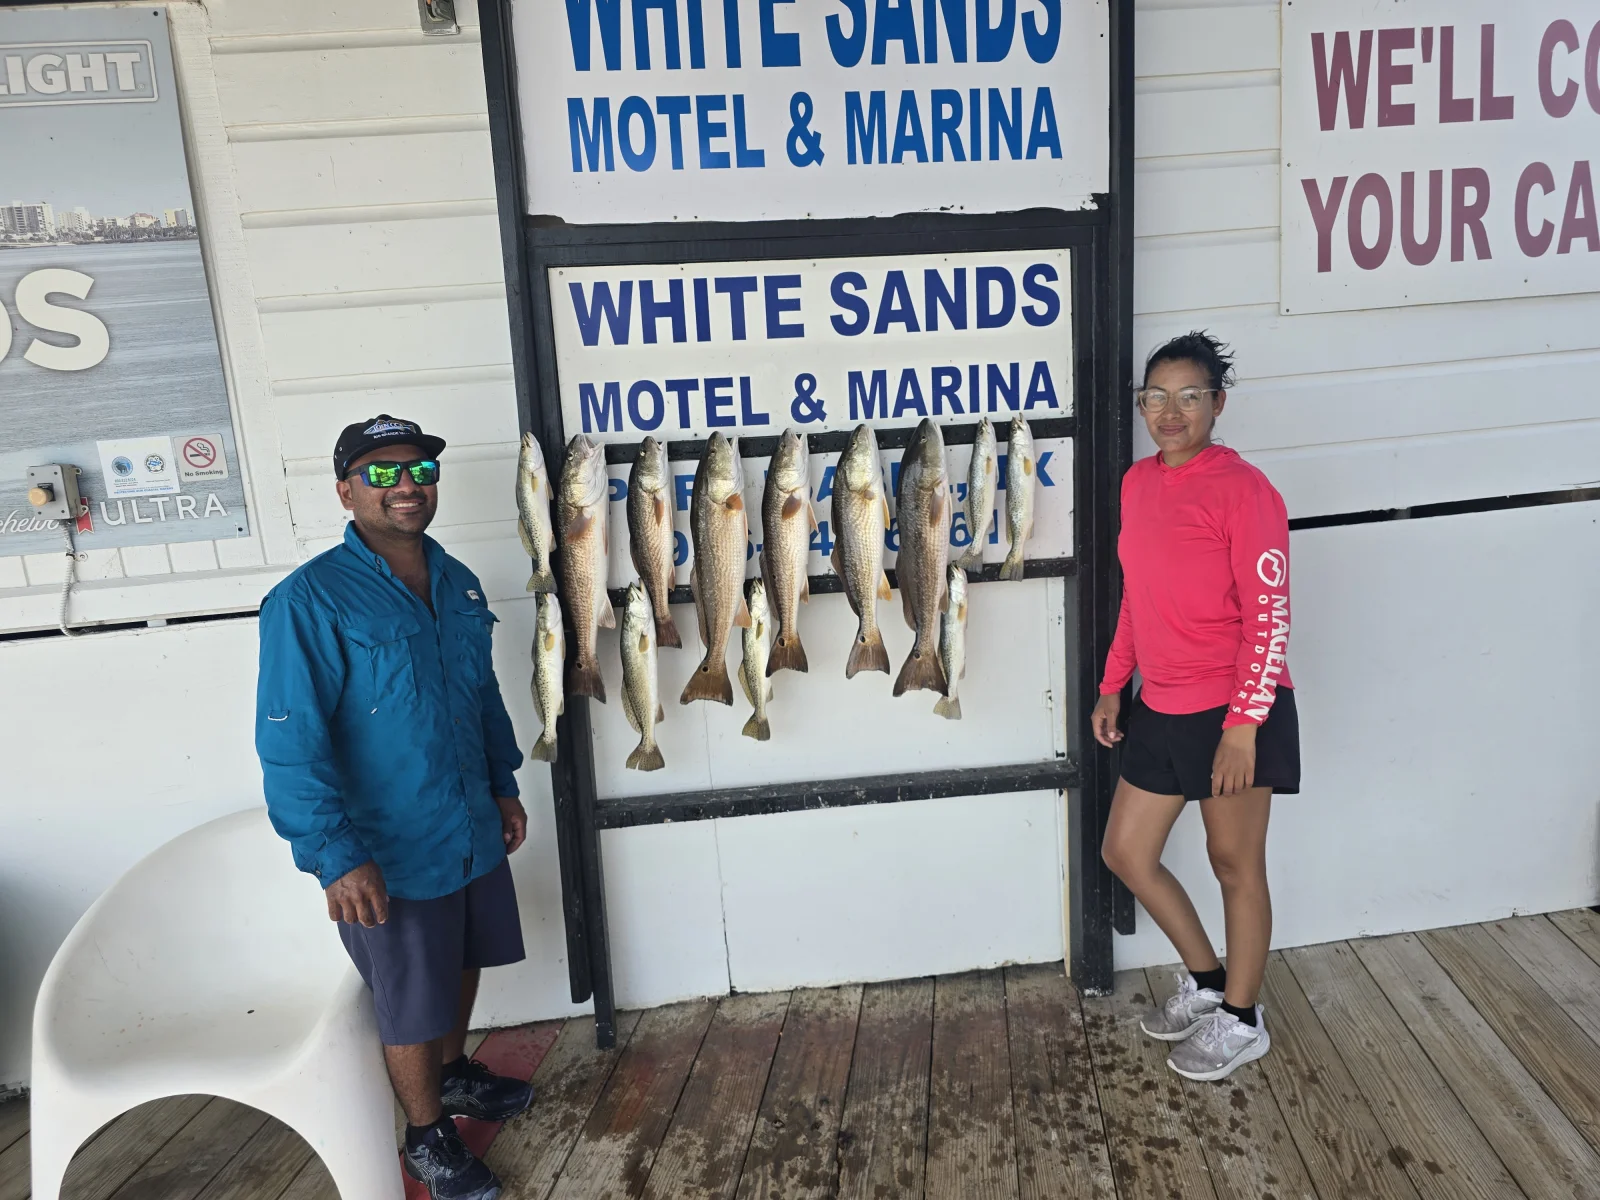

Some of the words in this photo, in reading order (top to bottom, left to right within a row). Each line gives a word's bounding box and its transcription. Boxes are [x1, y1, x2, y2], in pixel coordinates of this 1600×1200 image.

[1311, 25, 1514, 131] WE'LL
[567, 94, 765, 173] MOTEL
[786, 92, 825, 168] &
[845, 86, 1063, 165] MARINA
[1301, 168, 1492, 272] YOUR
[0, 268, 110, 371] S
[569, 275, 805, 346] WHITE
[830, 264, 1060, 336] SANDS
[579, 376, 769, 433] MOTEL
[791, 373, 827, 423] &
[848, 361, 1058, 420] MARINA
[100, 493, 228, 526] ULTRA
[195, 469, 224, 477] Smoking
[1244, 594, 1290, 721] MAGELLAN
